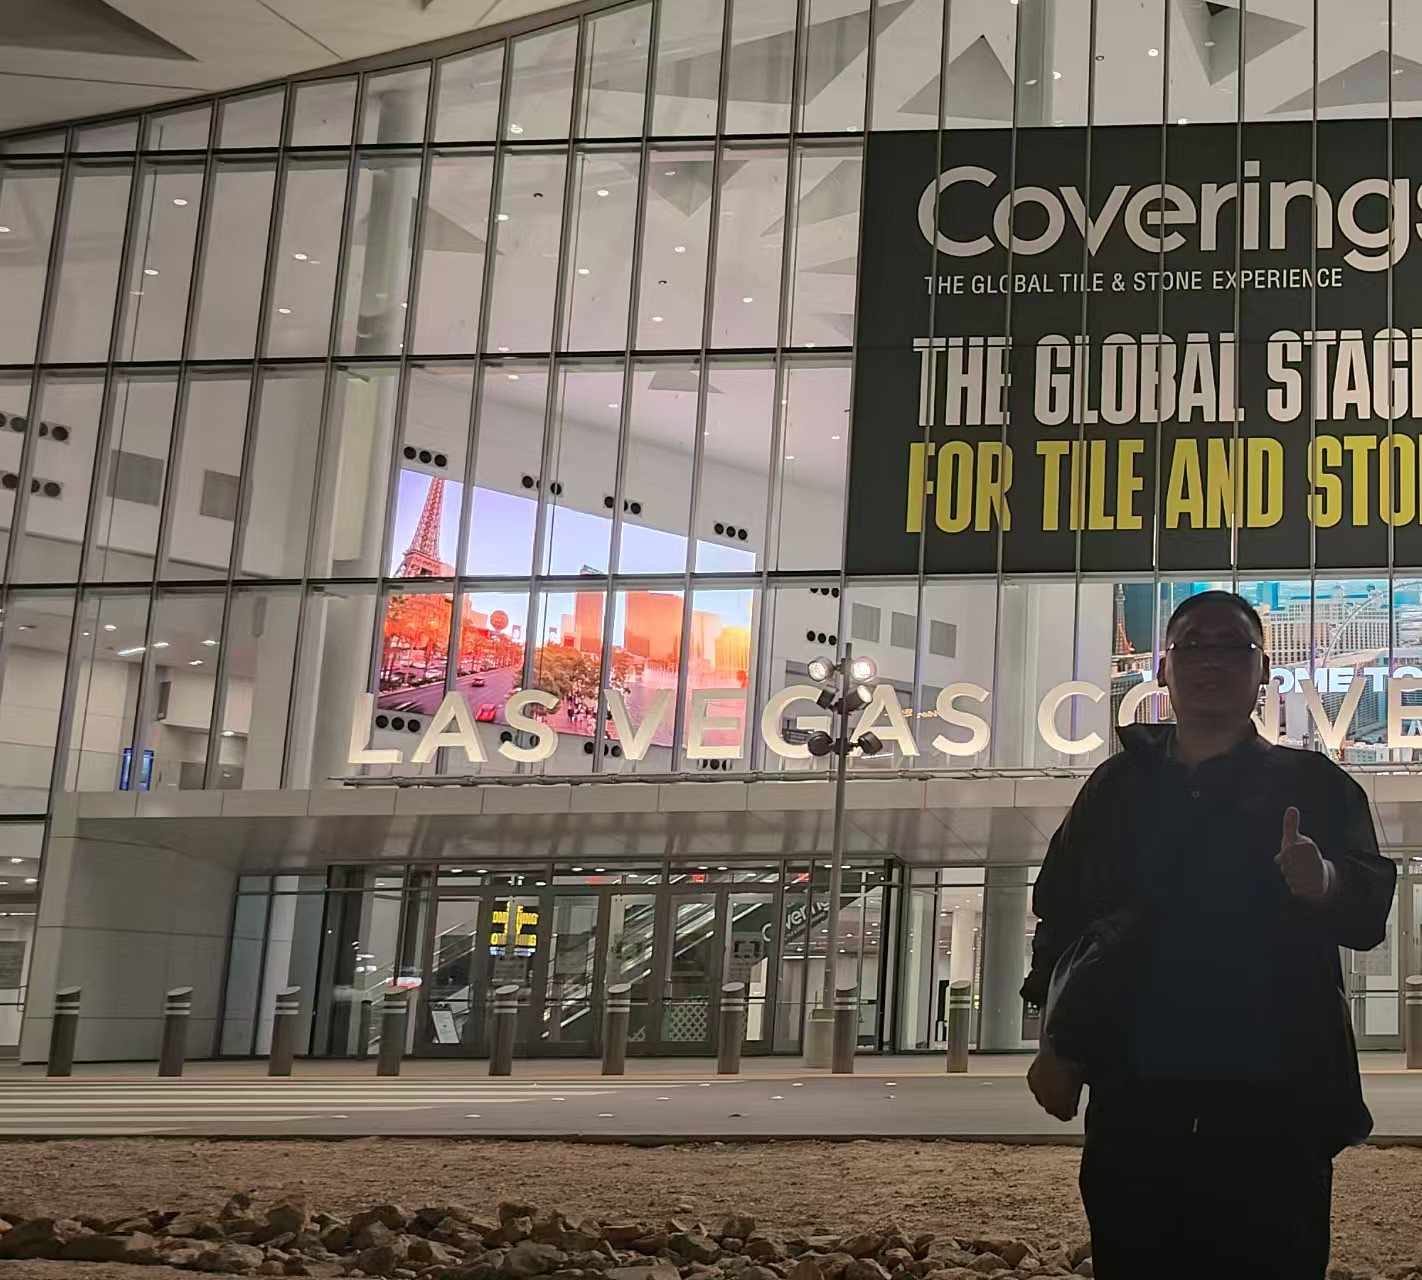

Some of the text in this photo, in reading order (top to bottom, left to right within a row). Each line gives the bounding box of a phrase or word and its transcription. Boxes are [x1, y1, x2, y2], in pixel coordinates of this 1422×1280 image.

[924, 267, 1343, 296] THE GLOBAL TILE & STONE EXPERIENCE
[912, 336, 1014, 427] THE
[1034, 332, 1245, 425] GLOBAL
[906, 440, 1014, 533] FOR
[1036, 438, 1144, 532] TILE
[1165, 436, 1284, 530] AND
[347, 689, 561, 764] LAS
[603, 682, 991, 762] VEGAS
